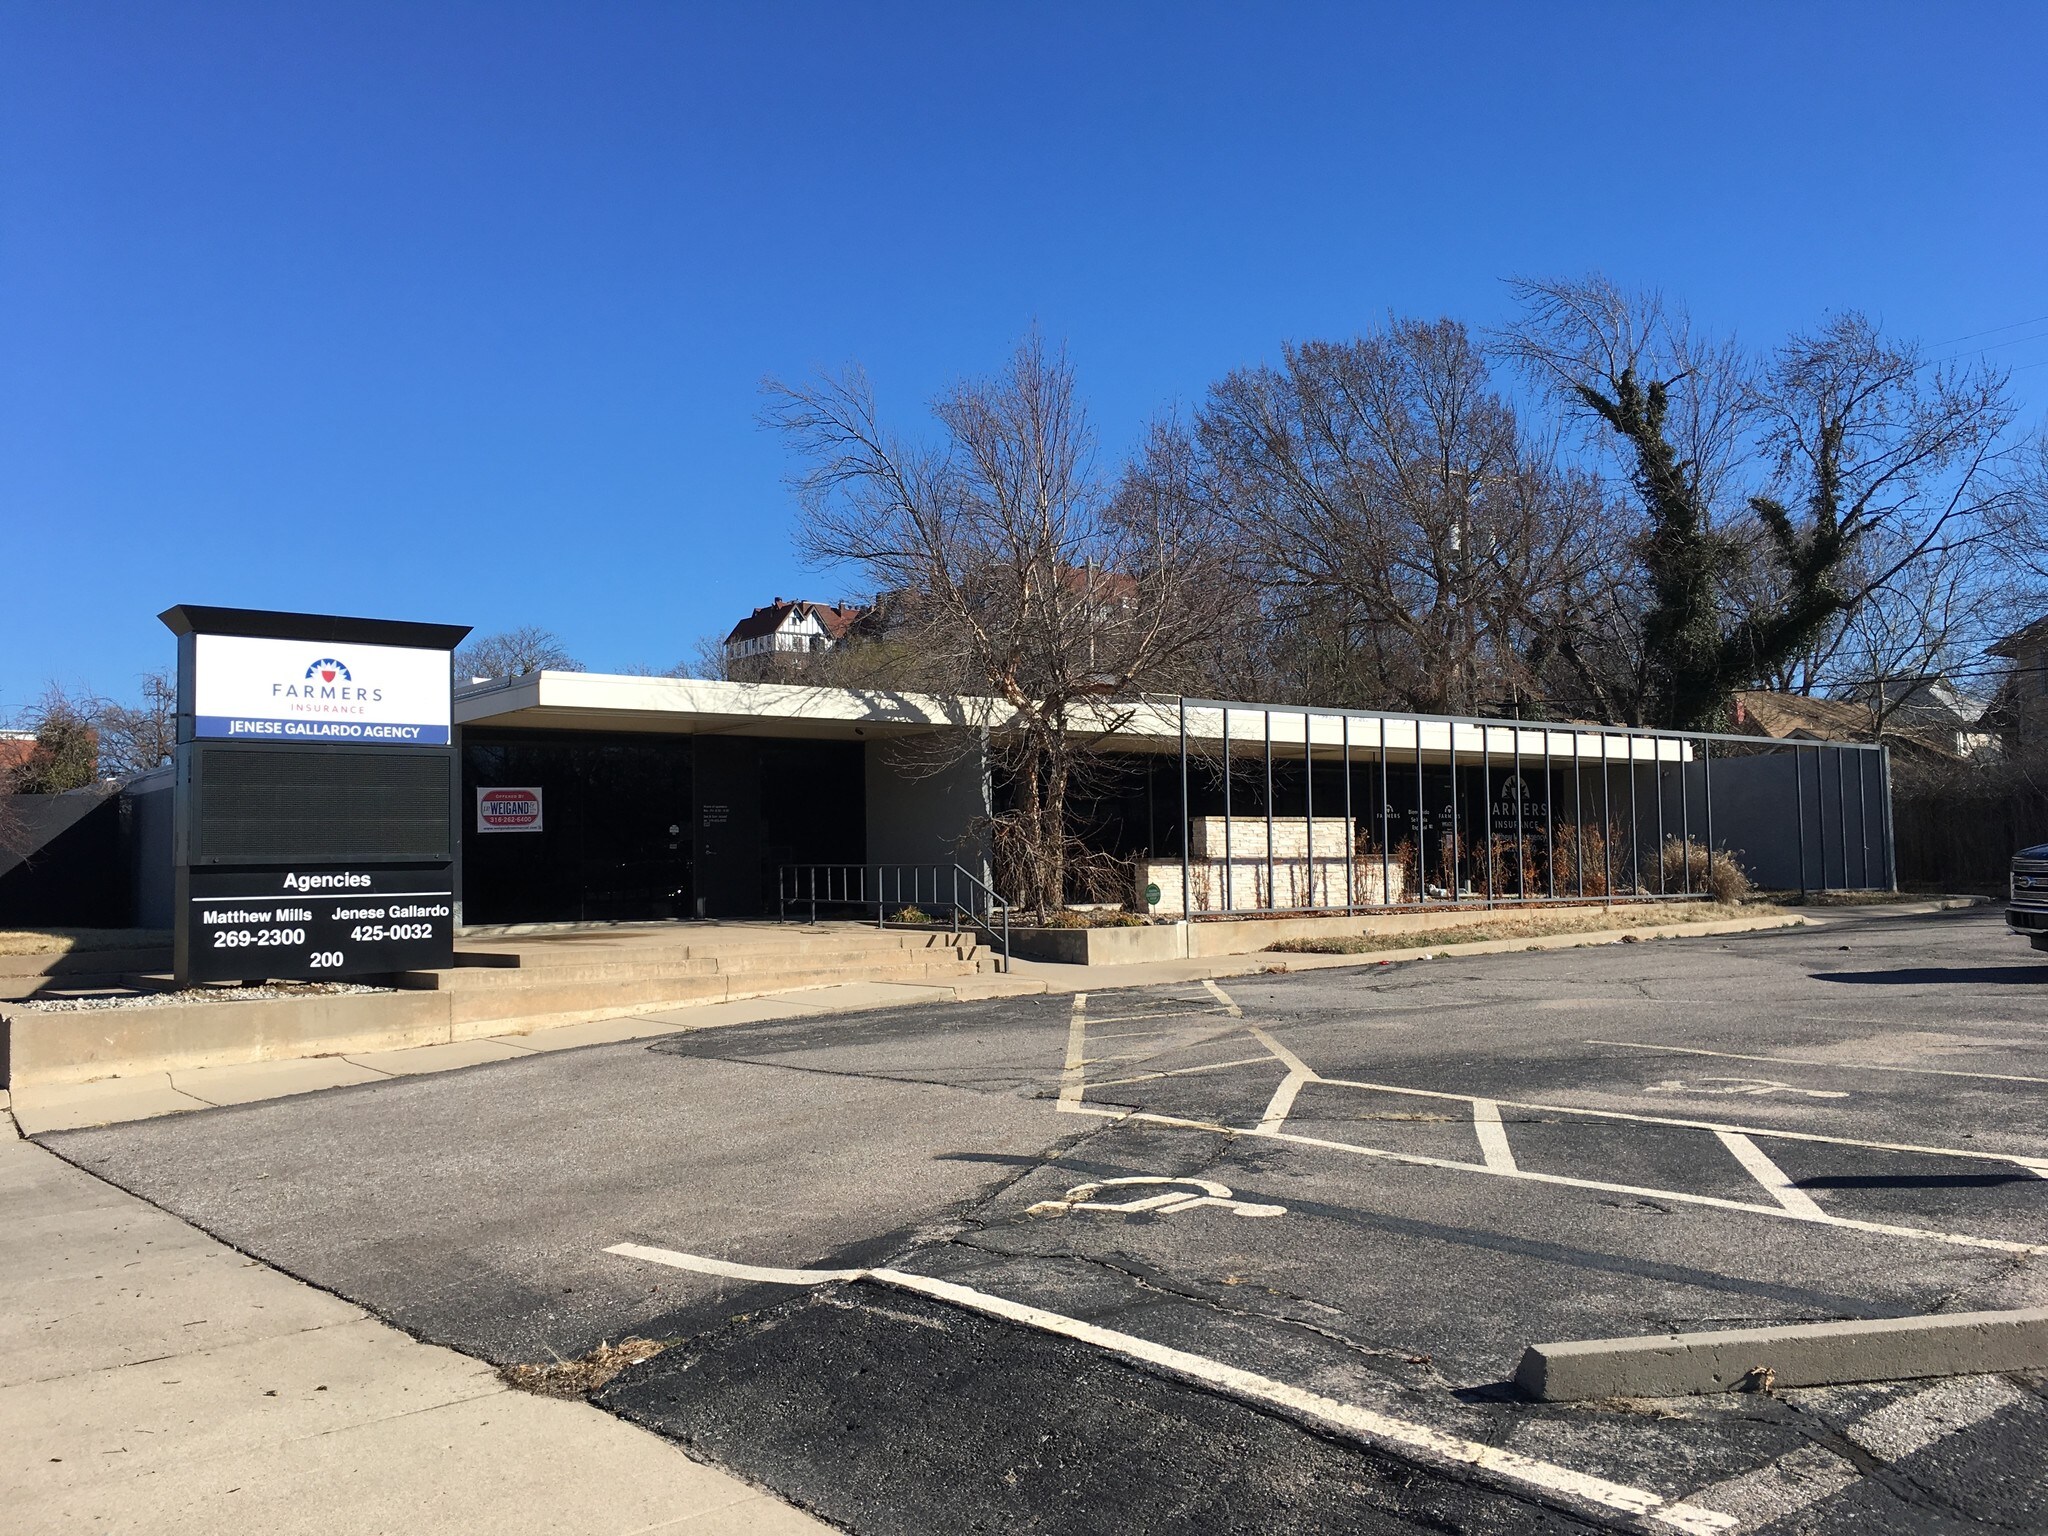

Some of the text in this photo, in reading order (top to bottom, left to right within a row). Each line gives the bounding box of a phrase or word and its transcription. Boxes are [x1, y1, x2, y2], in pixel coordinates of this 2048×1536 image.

[272, 683, 382, 702] FARMERS
[290, 704, 365, 714] INSURANCE
[229, 720, 420, 739] JENESE GALLARDO AGENCY
[490, 802, 529, 815] WEIGAND
[1491, 803, 1547, 816] ARMERS
[283, 872, 371, 891] Agencies
[203, 908, 312, 924] Matthew Mills
[332, 903, 450, 920] Jenese Gallardo
[213, 929, 305, 948] 269-2300
[350, 924, 433, 941] 425-0032
[309, 952, 344, 968] 200
